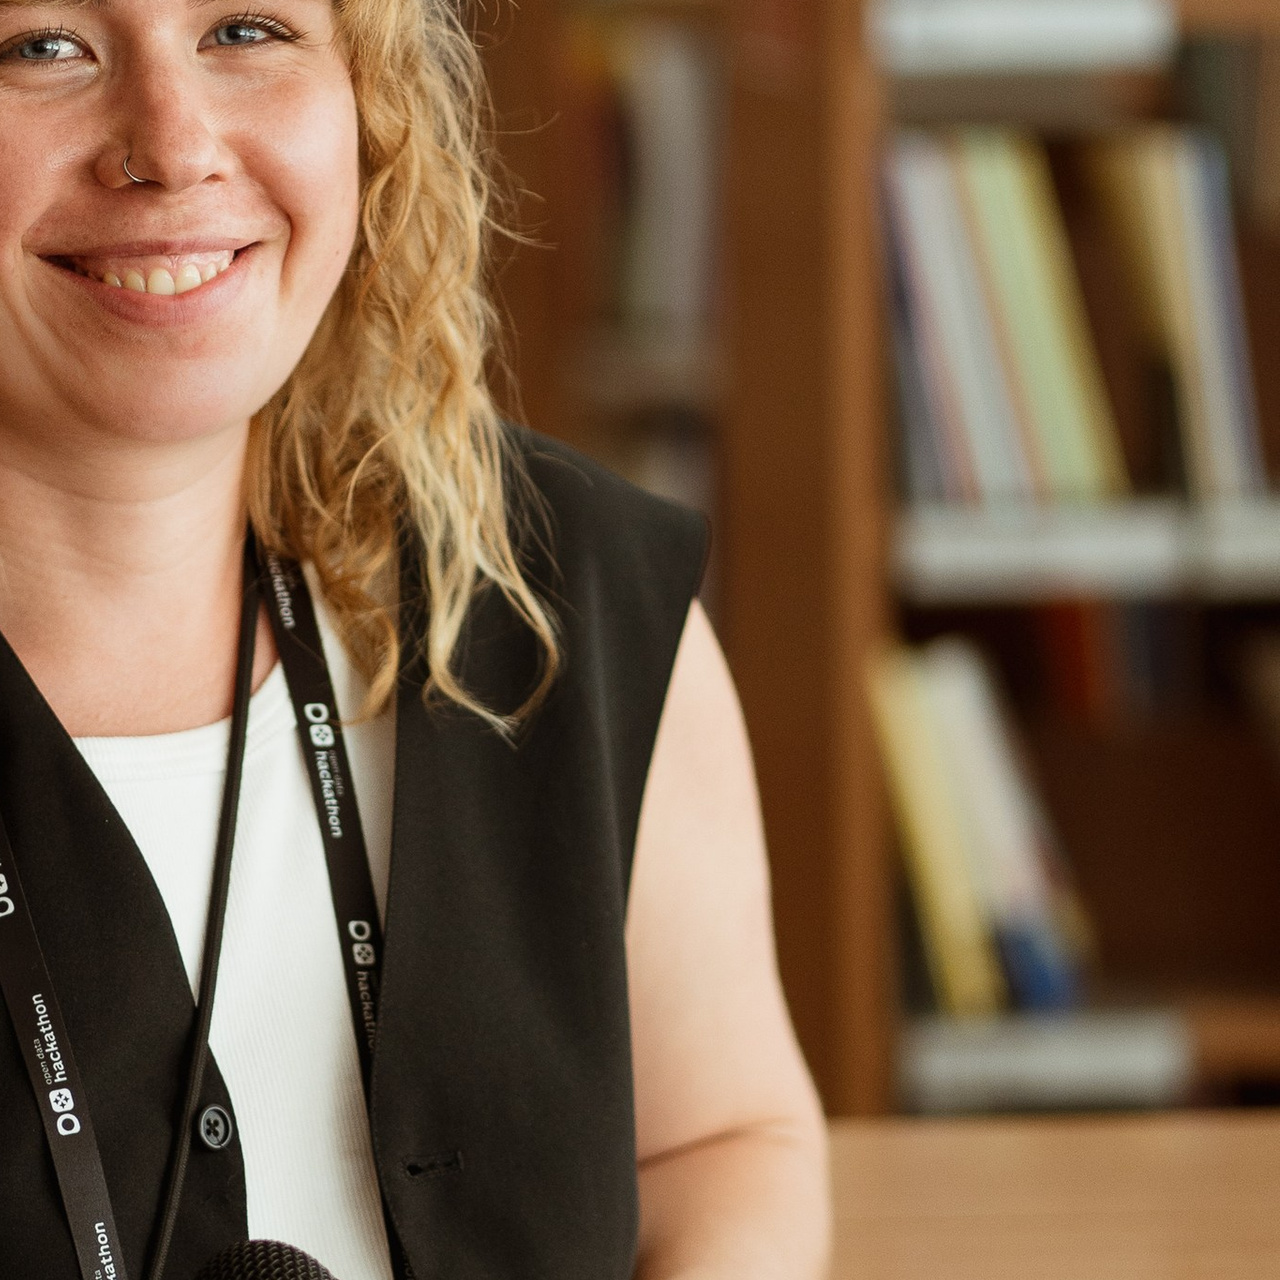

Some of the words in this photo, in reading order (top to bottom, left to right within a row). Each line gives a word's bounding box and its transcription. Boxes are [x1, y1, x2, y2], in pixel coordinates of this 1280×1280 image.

[315, 750, 343, 838] hackathon
[32, 993, 68, 1083] hackathon
[33, 1038, 45, 1060] data
[40, 1061, 52, 1085] open
